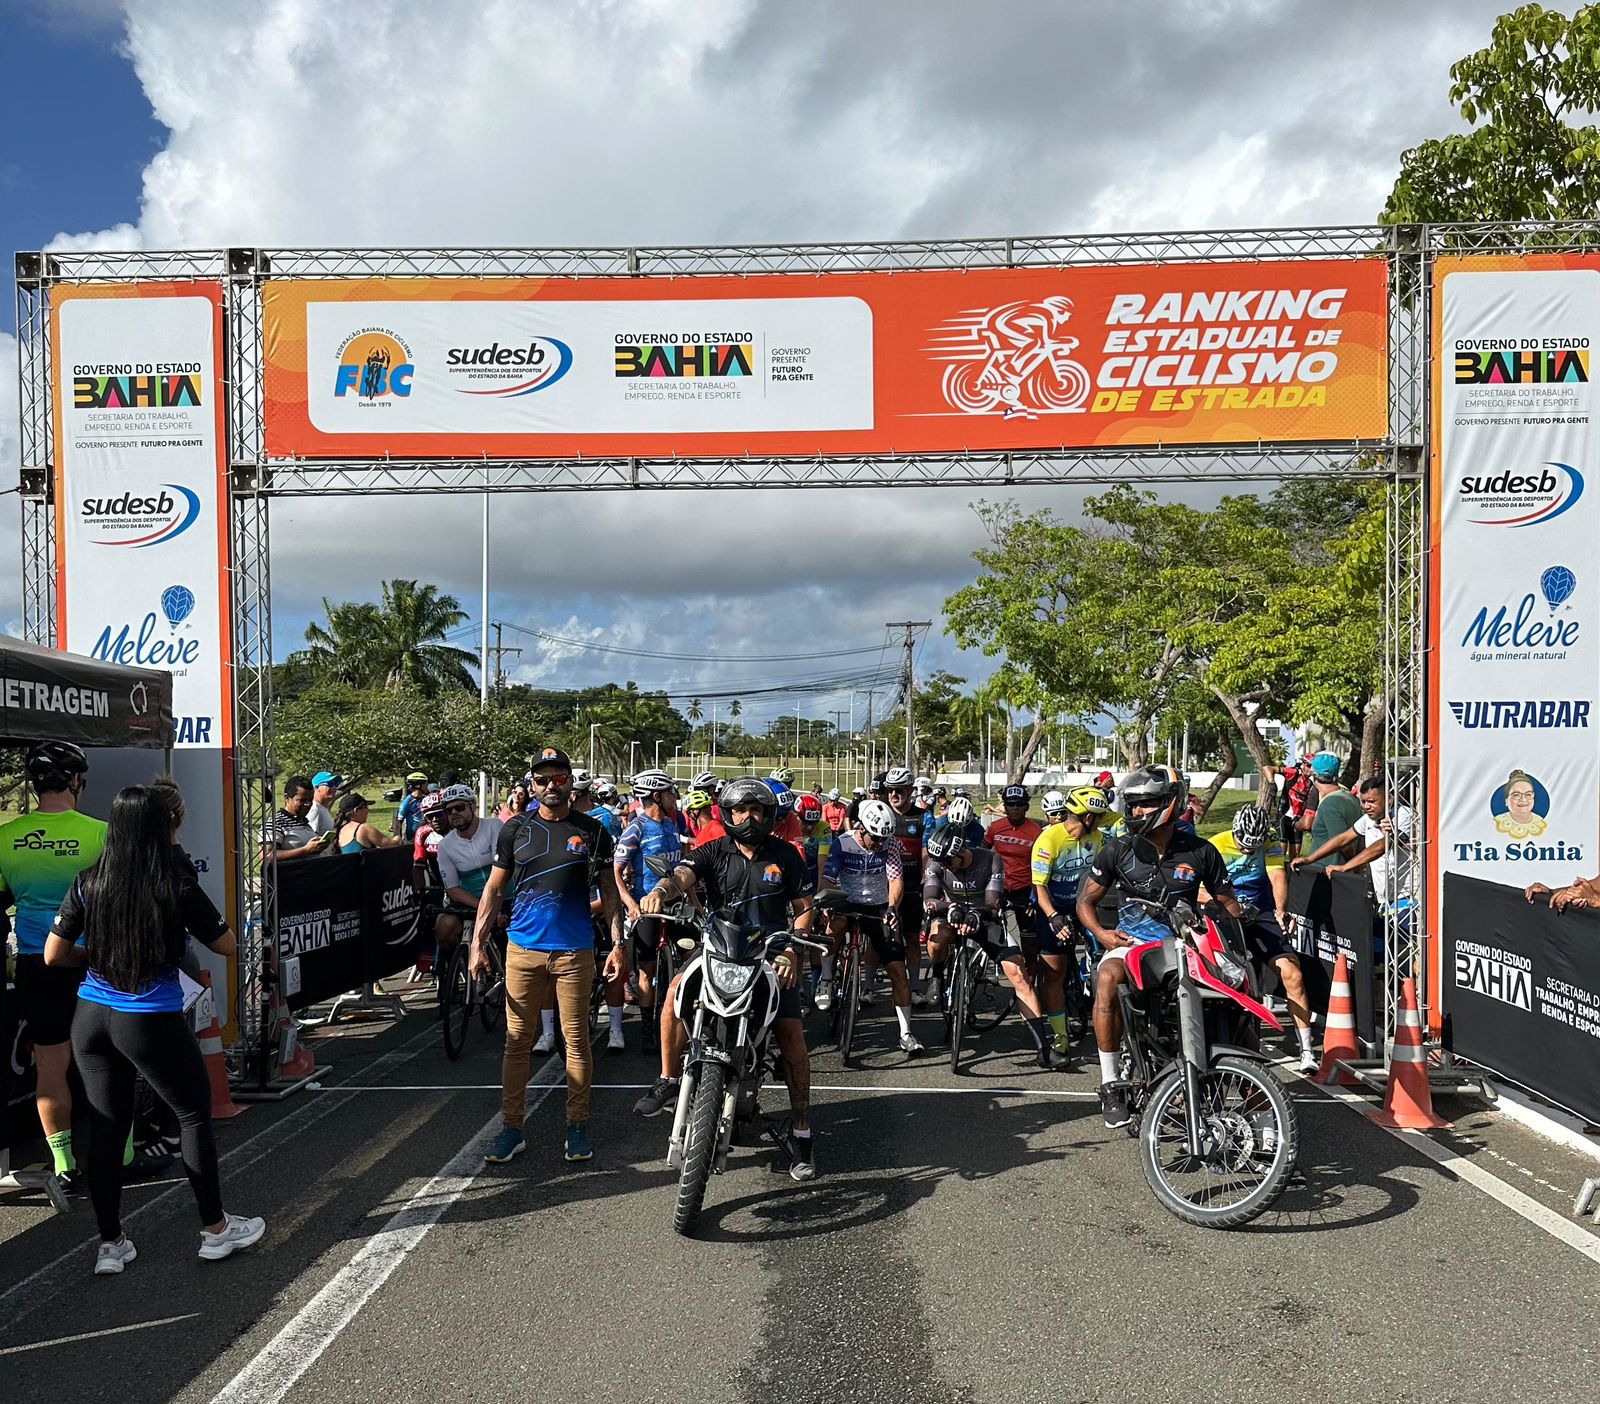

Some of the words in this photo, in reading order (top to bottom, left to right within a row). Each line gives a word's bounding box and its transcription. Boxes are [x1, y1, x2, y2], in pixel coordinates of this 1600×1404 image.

[1105, 288, 1348, 324] RANKING
[336, 330, 360, 359] FEDERAÇÃO
[394, 334, 413, 358] CICLISMO
[614, 334, 678, 344] GOVERNO
[682, 334, 700, 343] DO
[704, 332, 752, 343] ESTADO
[1102, 326, 1296, 353] ESTADUAL
[1304, 330, 1342, 346] DE
[1455, 340, 1516, 350] GOVERNO
[1520, 339, 1538, 349] DO
[1542, 338, 1590, 348] ESTADO
[446, 343, 545, 365] sudesb
[615, 345, 752, 377] BAHIA
[1455, 350, 1589, 384] BAHIA
[74, 364, 132, 375] GOVERNO
[136, 364, 154, 374] DO
[156, 362, 201, 373] ESTADO
[1097, 351, 1338, 388] CICLISMO
[74, 375, 202, 408] BAHIA
[628, 382, 677, 390] SECRETARIA
[680, 382, 690, 390] DO
[692, 382, 737, 390] TRABALHO,
[1090, 390, 1142, 412] DE
[1150, 386, 1326, 411] ESTRADA
[148, 412, 189, 420] TRABALHO,
[1459, 470, 1556, 494] sudesb
[81, 492, 174, 516] sudesb
[1461, 594, 1580, 647] Meleve
[91, 612, 200, 664] Meleve
[1470, 652, 1492, 662] água
[1495, 652, 1530, 660] mineral
[1533, 651, 1566, 660] natural
[1463, 701, 1590, 728] ULTRABAR
[14, 839, 80, 850] PORTO
[994, 834, 1034, 847] SCOTT
[1454, 841, 1500, 861] Tia
[1506, 840, 1582, 861] Sônia
[382, 880, 413, 912] sude
[280, 913, 305, 927] GOVERNO
[306, 912, 312, 922] DO
[314, 908, 331, 920] ESTADO
[280, 919, 330, 958] BAHIA
[1456, 940, 1490, 958] GOVERNO
[1492, 948, 1502, 961] DO
[1503, 951, 1531, 971] ESTADO
[1456, 952, 1532, 1012] BAHIA
[1547, 977, 1591, 1004] SECRETARIA
[1535, 986, 1576, 1014] TRABALHO,
[1542, 1002, 1568, 1024] RENDA
[1569, 1014, 1574, 1026] E
